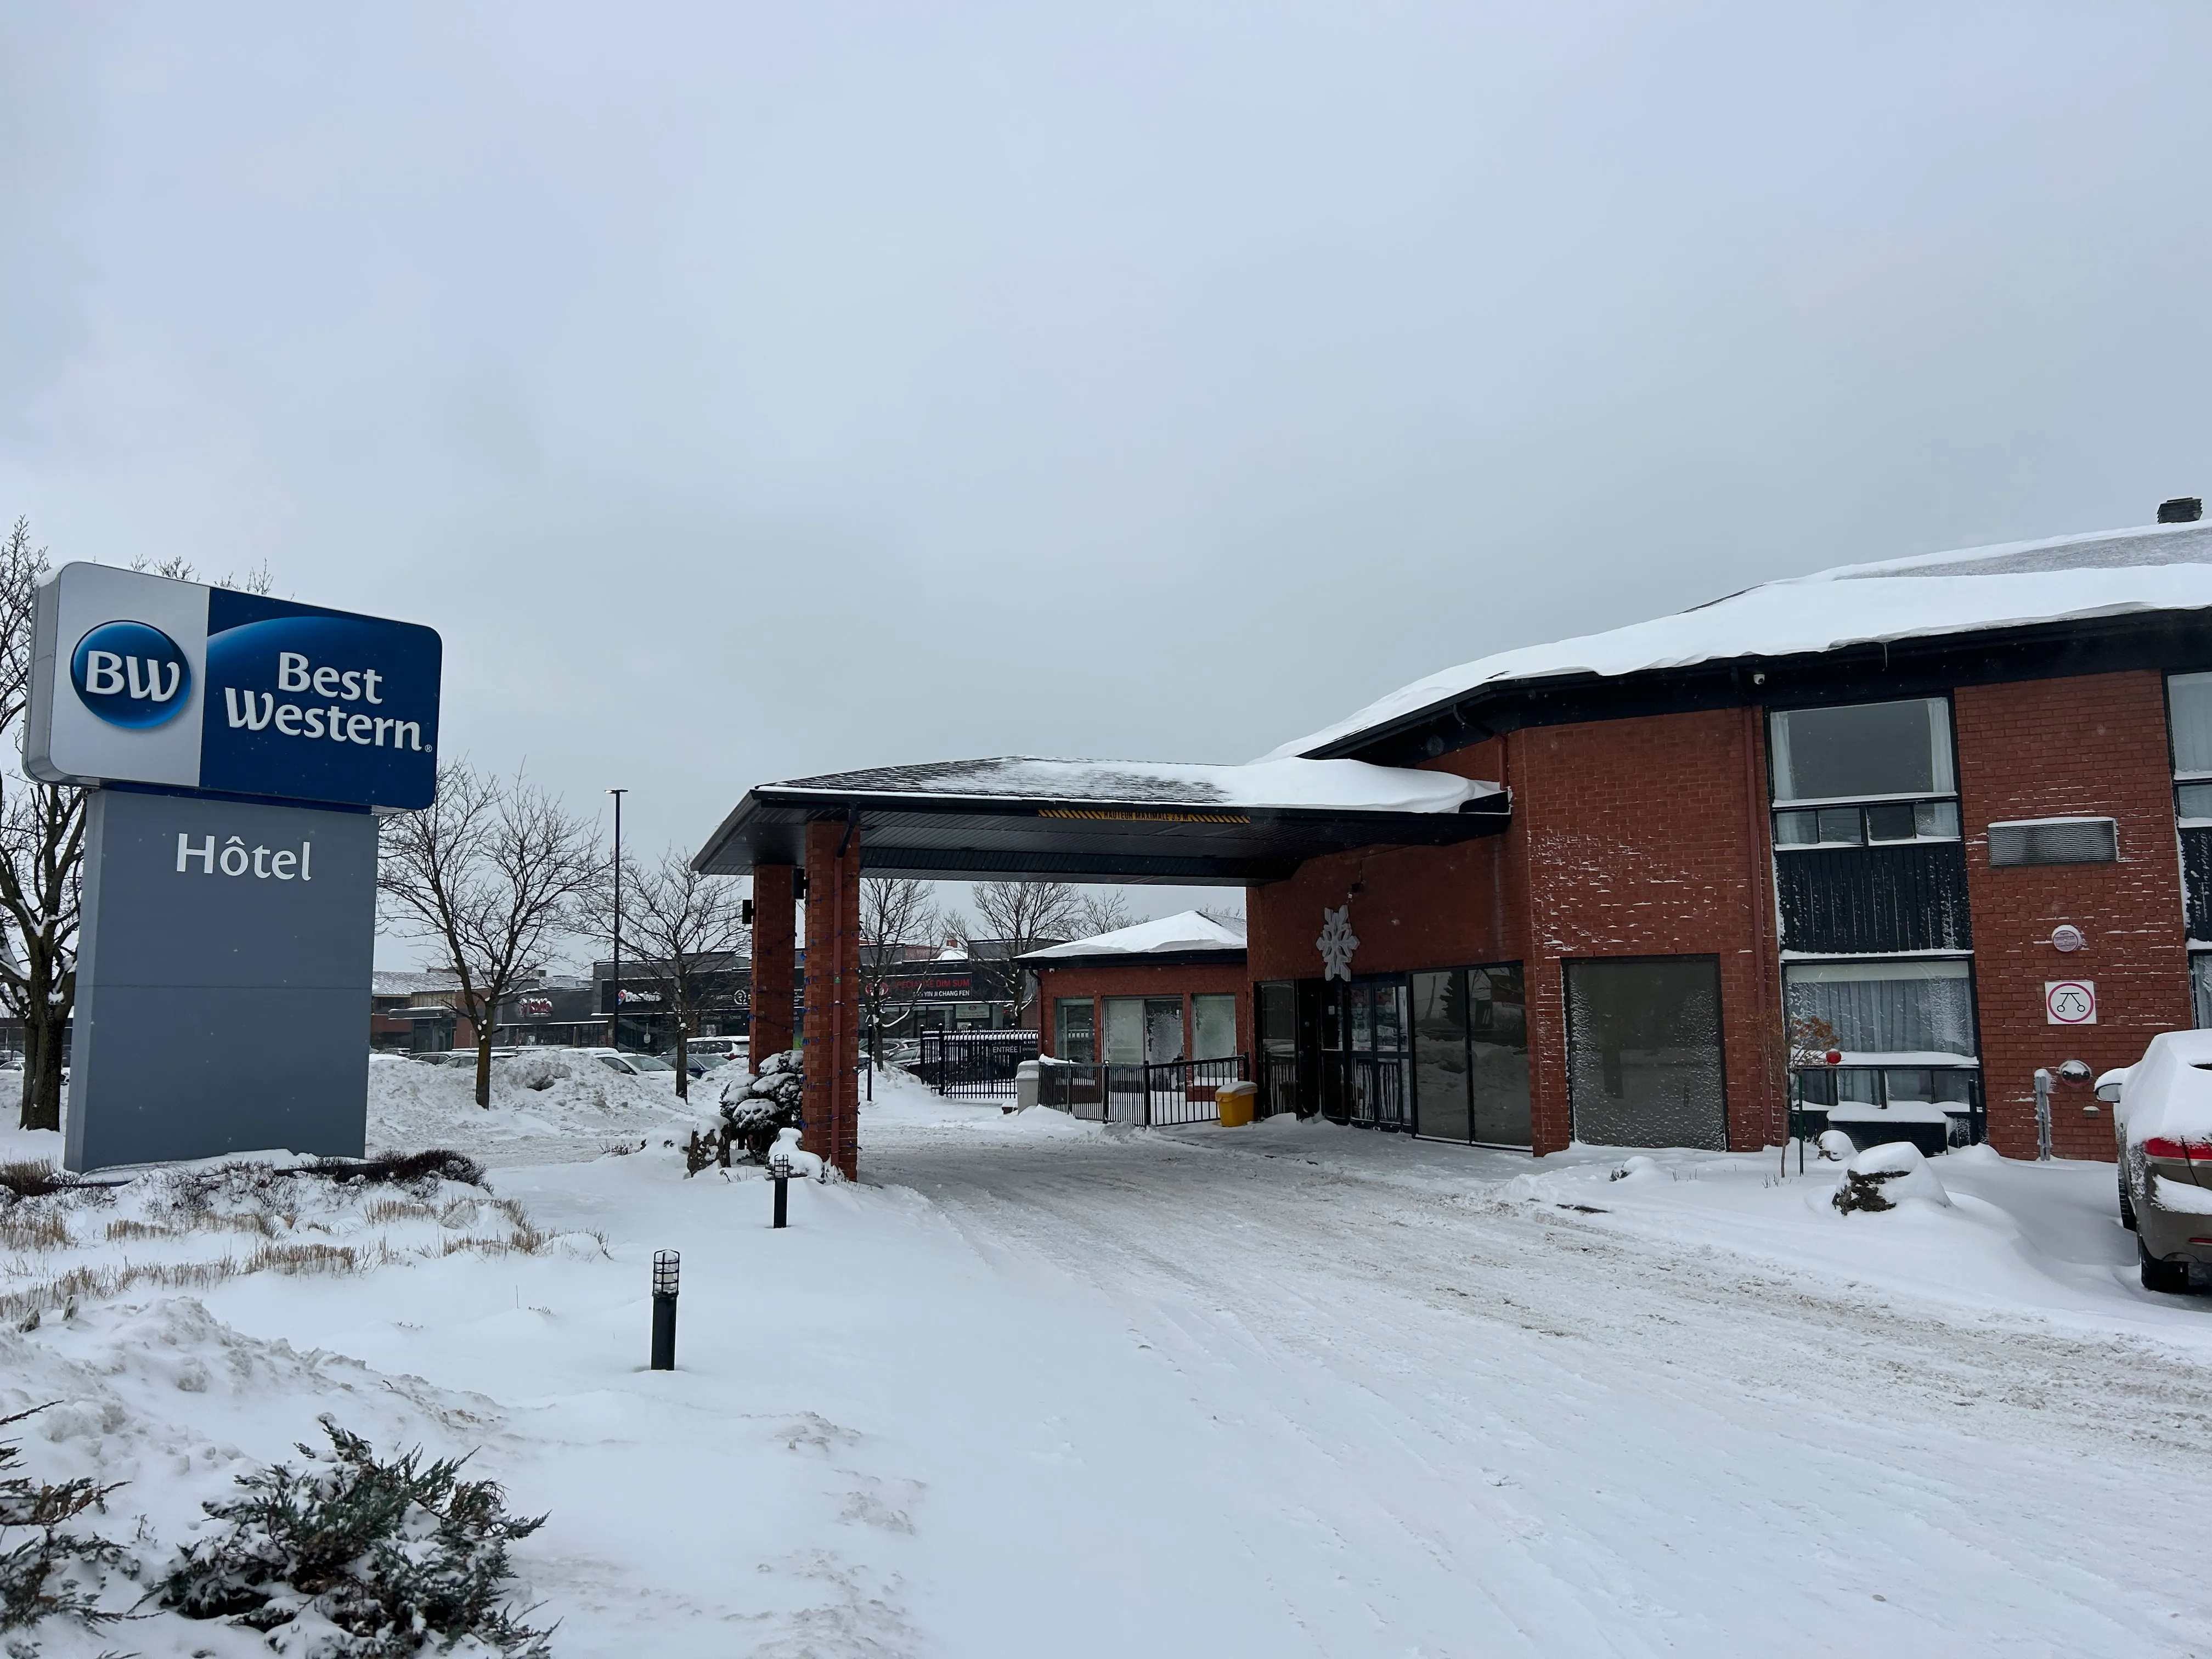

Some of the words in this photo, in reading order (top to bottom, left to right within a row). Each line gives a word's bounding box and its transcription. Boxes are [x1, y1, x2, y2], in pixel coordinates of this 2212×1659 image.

[86, 650, 180, 702] BW
[278, 652, 382, 704] Best
[1135, 812, 1169, 820] MAXIMALE
[177, 833, 311, 881] Hôtel
[936, 979, 950, 988] DIM
[952, 979, 970, 987] SUM
